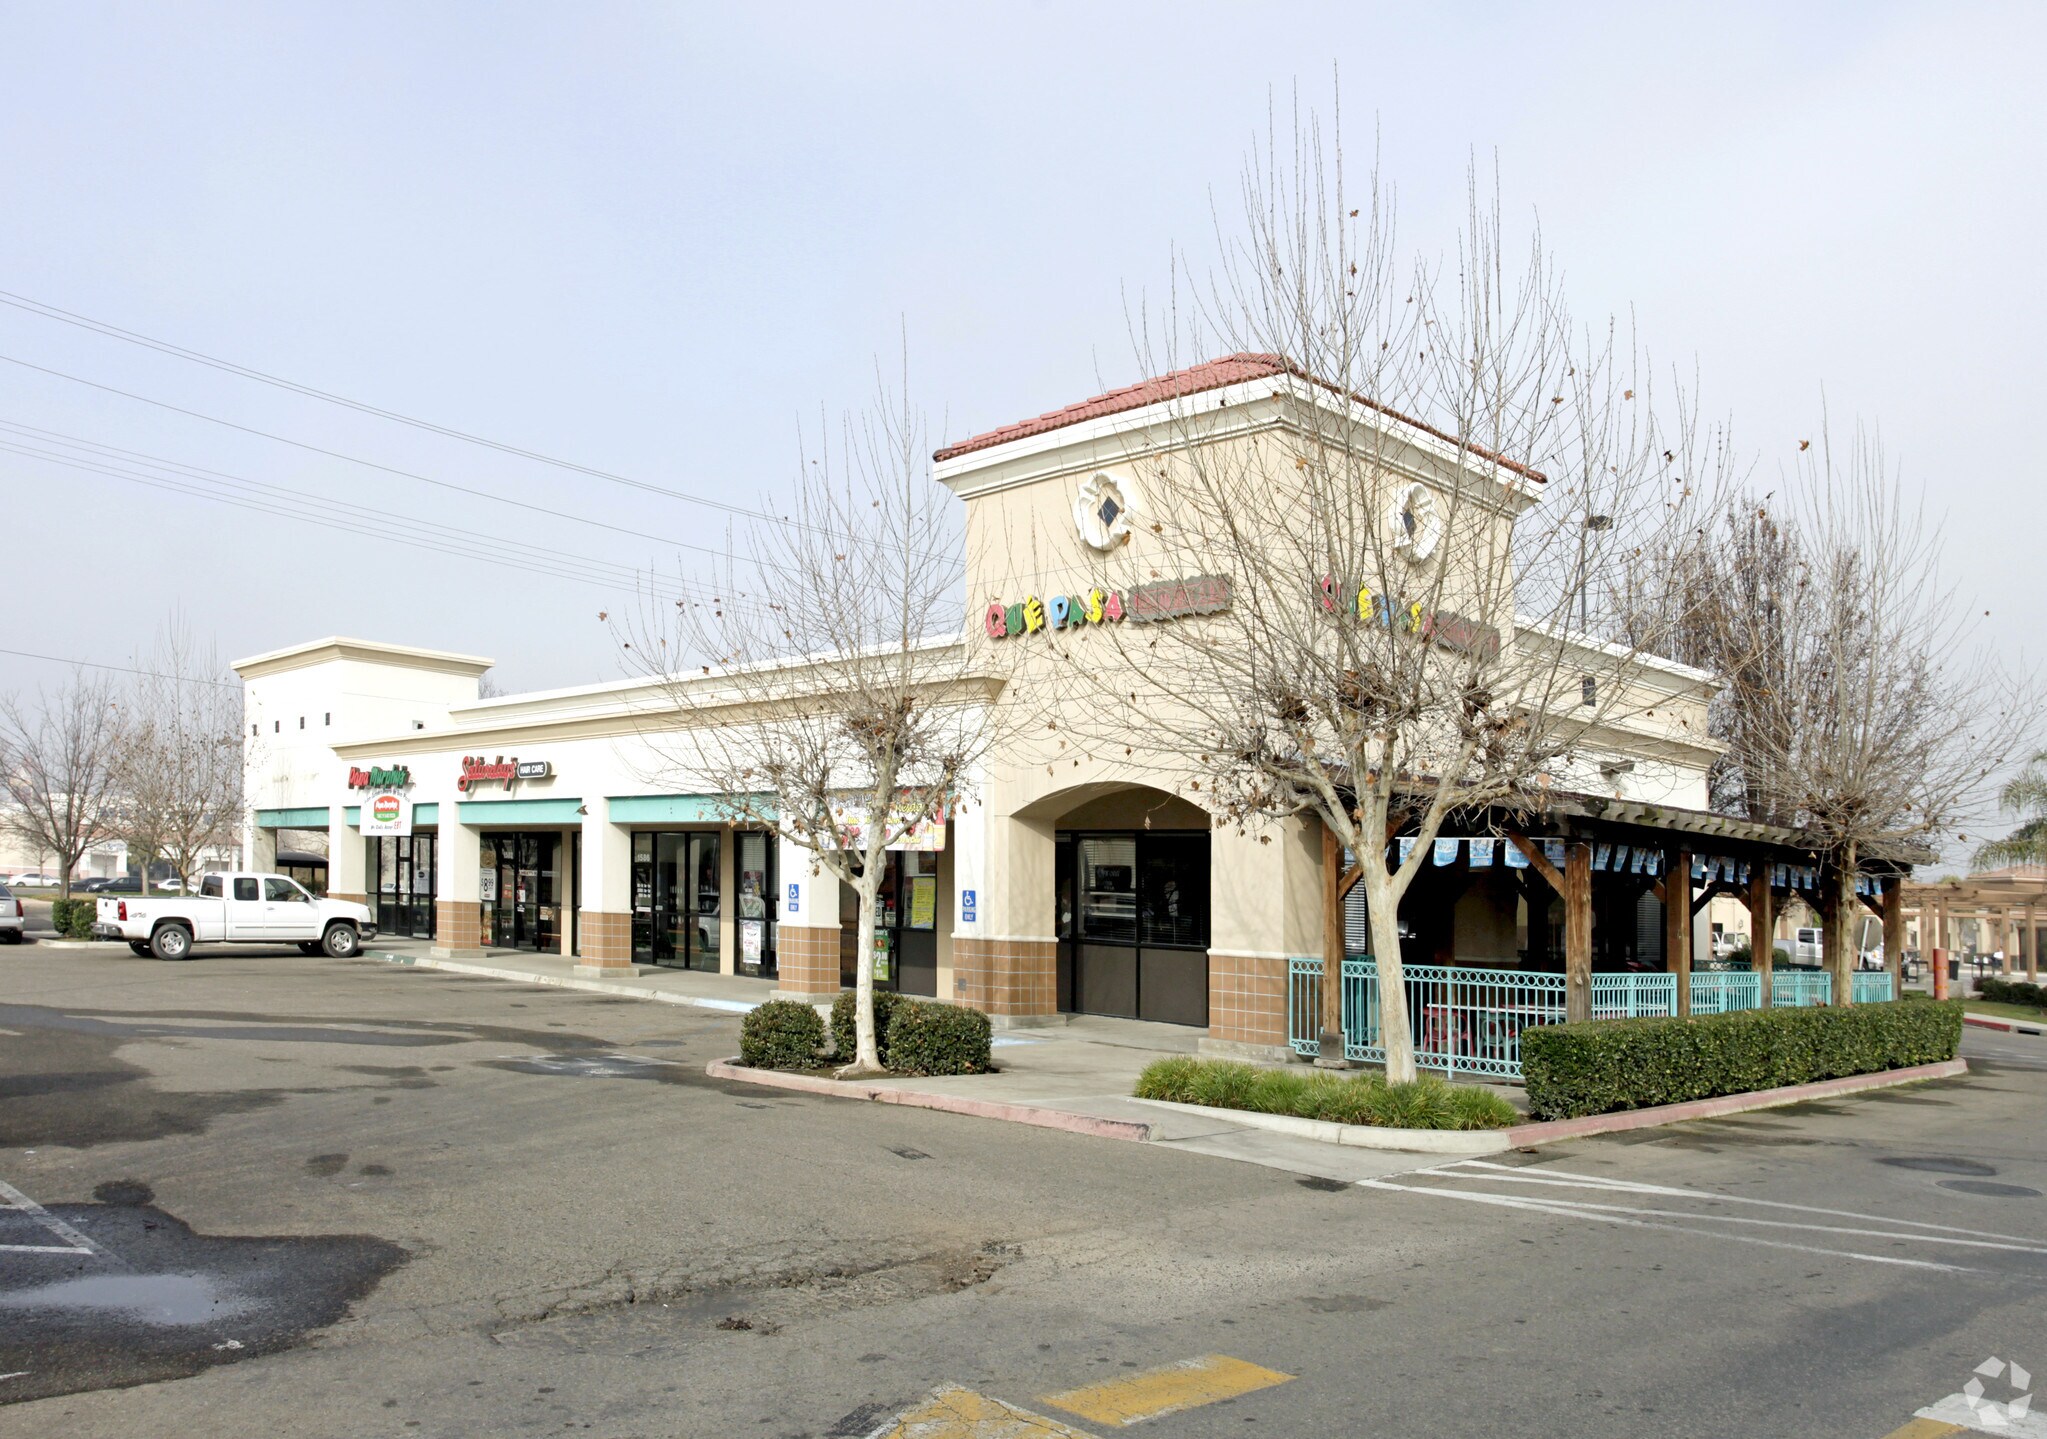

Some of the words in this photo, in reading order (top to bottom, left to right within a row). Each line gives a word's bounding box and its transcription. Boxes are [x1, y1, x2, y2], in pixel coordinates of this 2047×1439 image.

[985, 594, 1045, 638] QUÉ
[1049, 588, 1127, 629] PASA
[519, 765, 531, 774] HAIR
[531, 764, 544, 773] CARE
